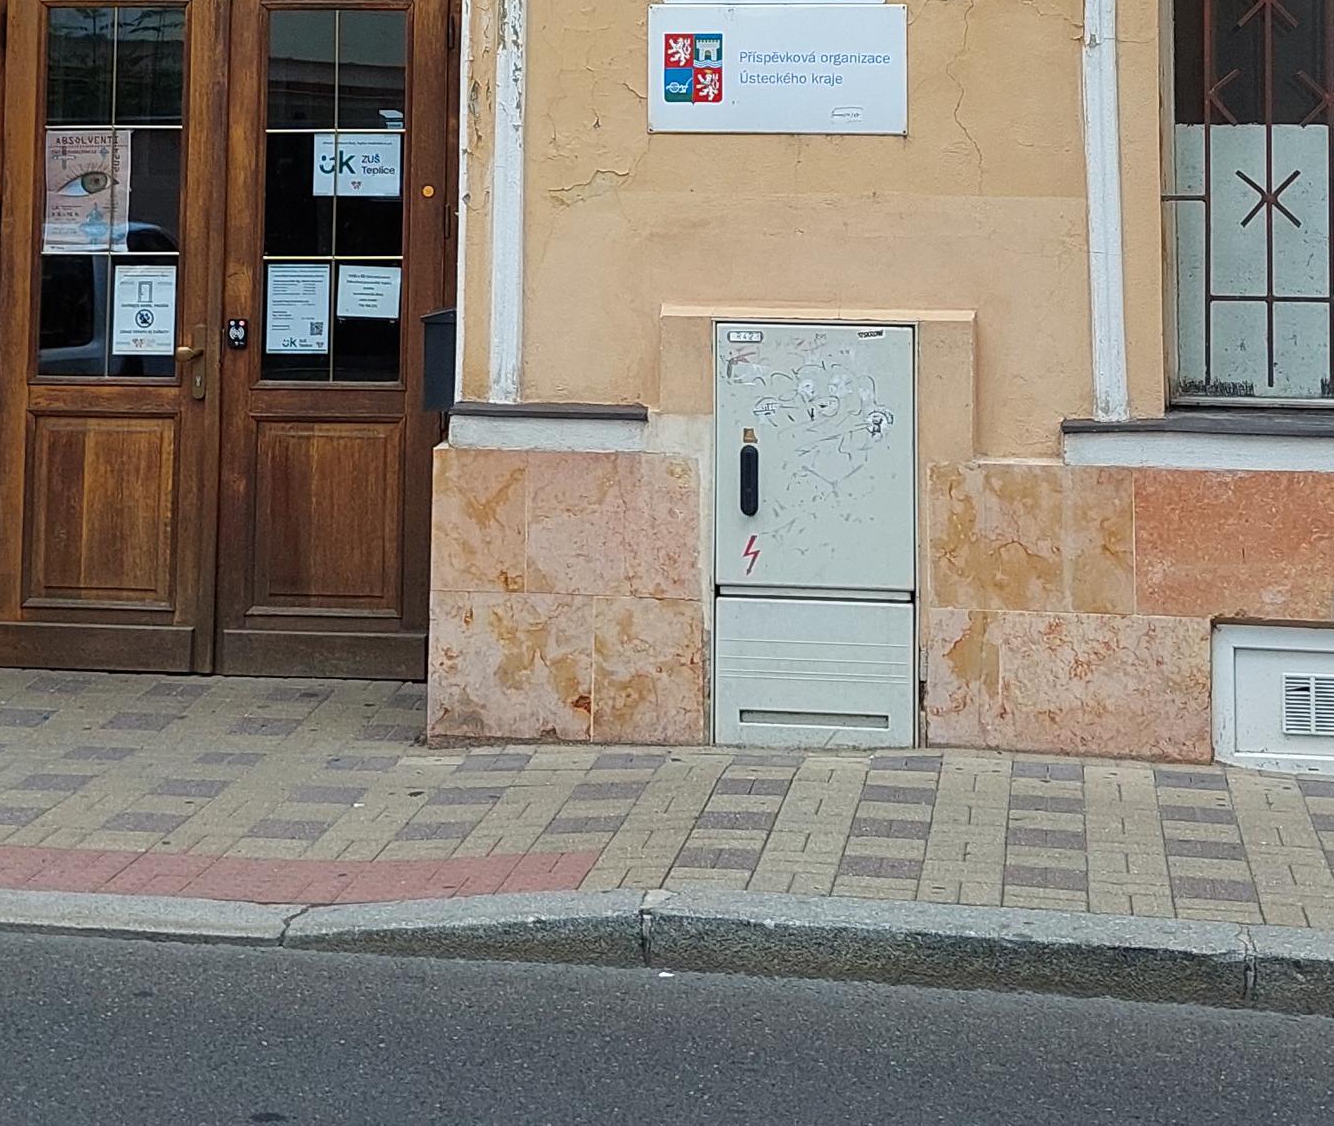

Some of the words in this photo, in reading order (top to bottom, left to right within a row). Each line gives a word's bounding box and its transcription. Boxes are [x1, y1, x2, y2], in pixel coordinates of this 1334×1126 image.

[739, 51, 816, 66] Příspěvková
[820, 51, 891, 66] organizace
[739, 69, 808, 84] Ústeckého
[811, 72, 844, 87] kraje
[361, 153, 381, 164] ZUŠ
[361, 165, 396, 177] Teplice
